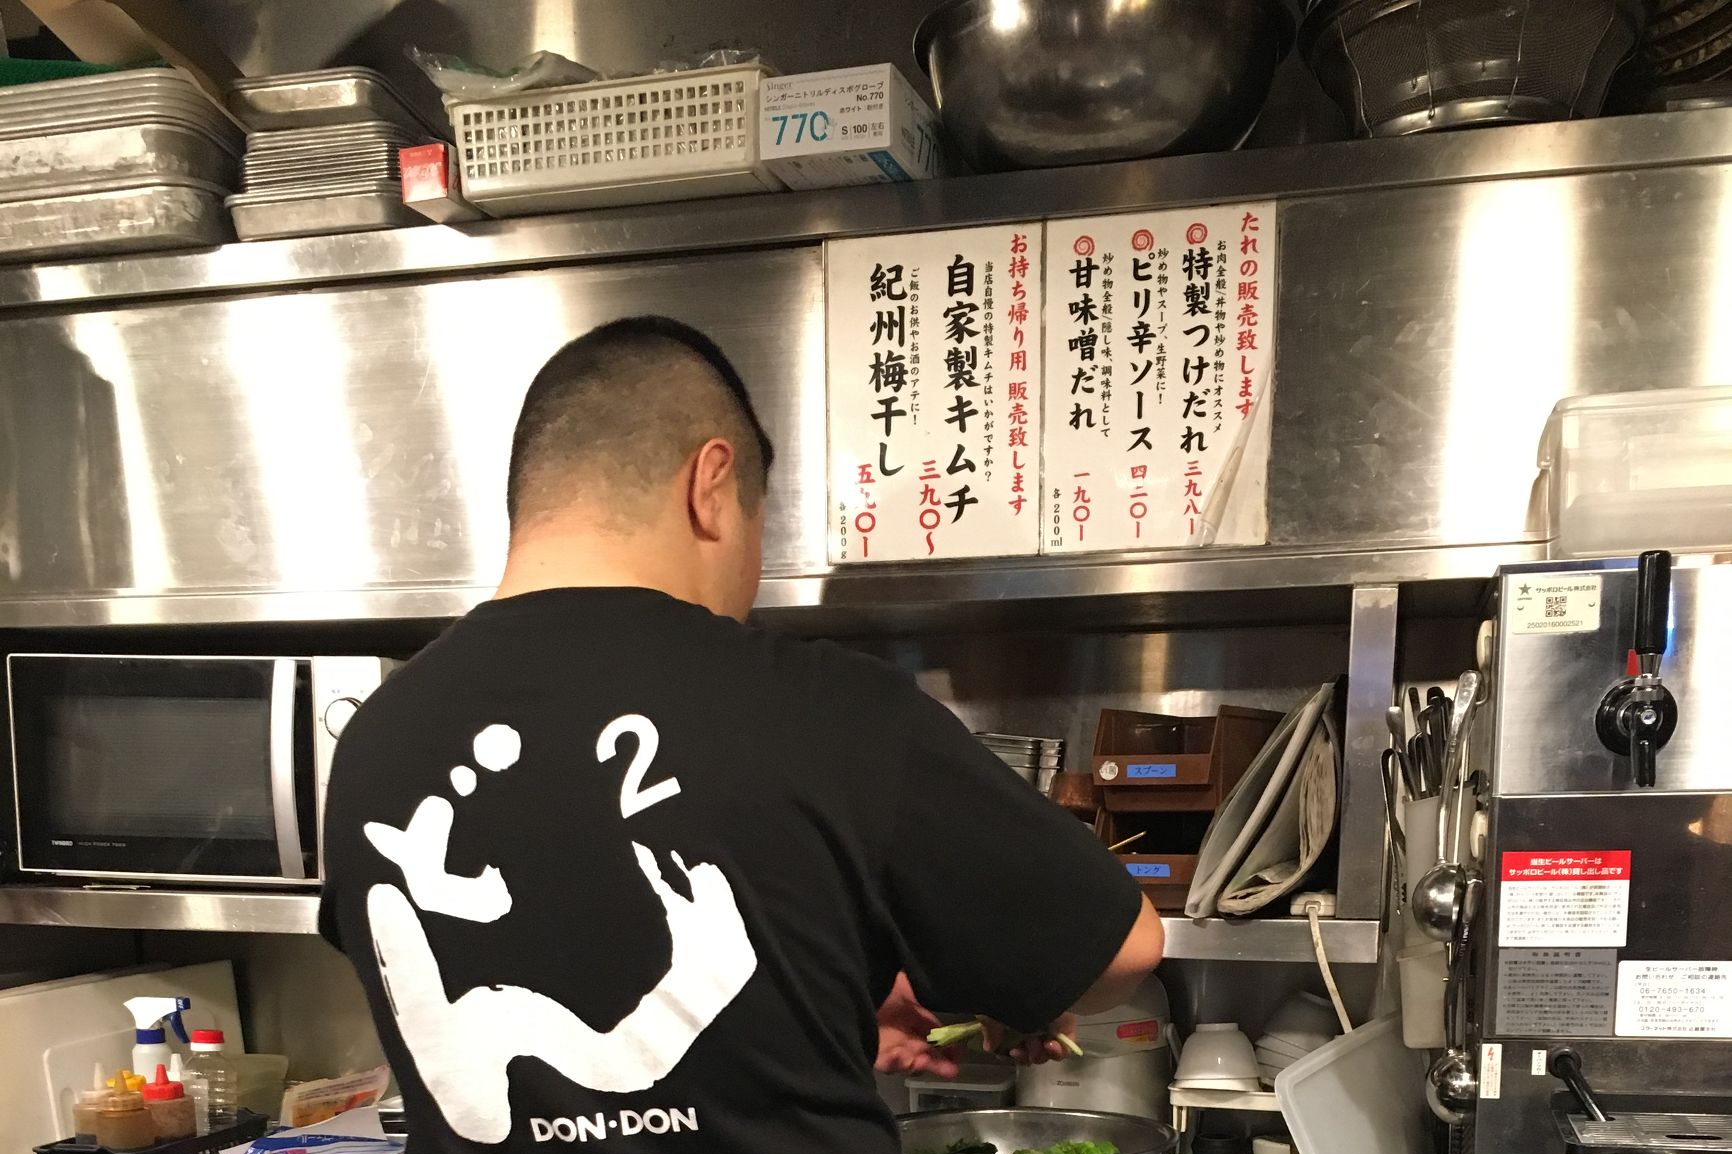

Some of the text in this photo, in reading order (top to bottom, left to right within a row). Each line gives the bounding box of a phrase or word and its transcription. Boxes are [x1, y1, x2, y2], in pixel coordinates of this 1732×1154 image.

[841, 124, 868, 135] S 100
[868, 263, 909, 477] 紀州梅干し
[943, 254, 981, 524] 自家製キムチ
[1008, 233, 1029, 516] お持ち帰り用 販売致します
[1068, 257, 1100, 430] 甘味噌だれ
[1126, 252, 1156, 452] ピリ辛ソース
[1180, 247, 1213, 454] 特製つけだれ
[1235, 212, 1260, 420] たれの販売致します
[1134, 765, 1168, 775] スプーン
[1137, 865, 1161, 875] トング
